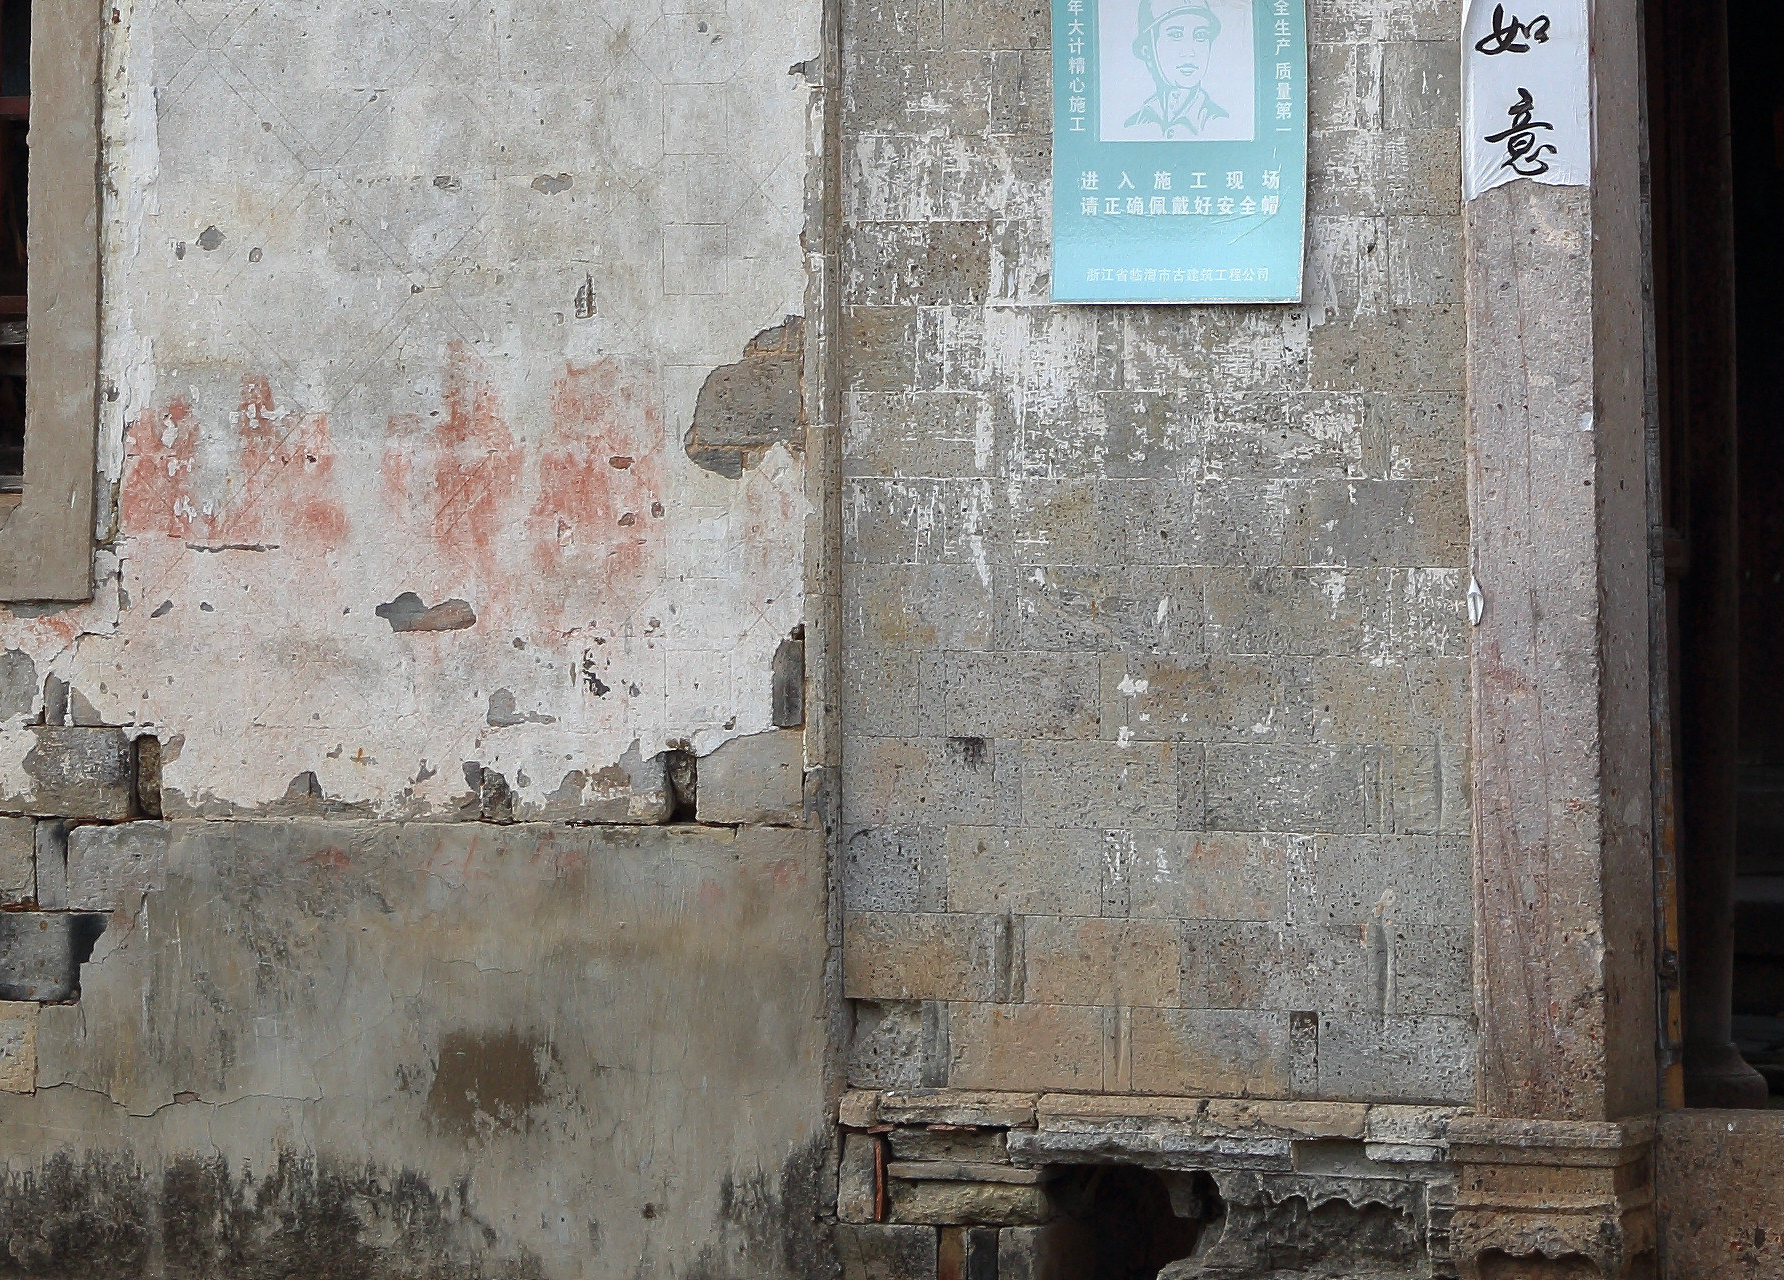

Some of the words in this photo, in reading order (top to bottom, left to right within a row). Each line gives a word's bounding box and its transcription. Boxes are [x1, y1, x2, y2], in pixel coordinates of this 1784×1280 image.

[1274, 62, 1293, 133] 质量第一
[1079, 170, 1281, 191] 进入施工现场
[1079, 195, 1281, 216] 请正确佩戴好安全帽
[1085, 267, 1270, 283] 浙江省临海市古建筑工程公司
